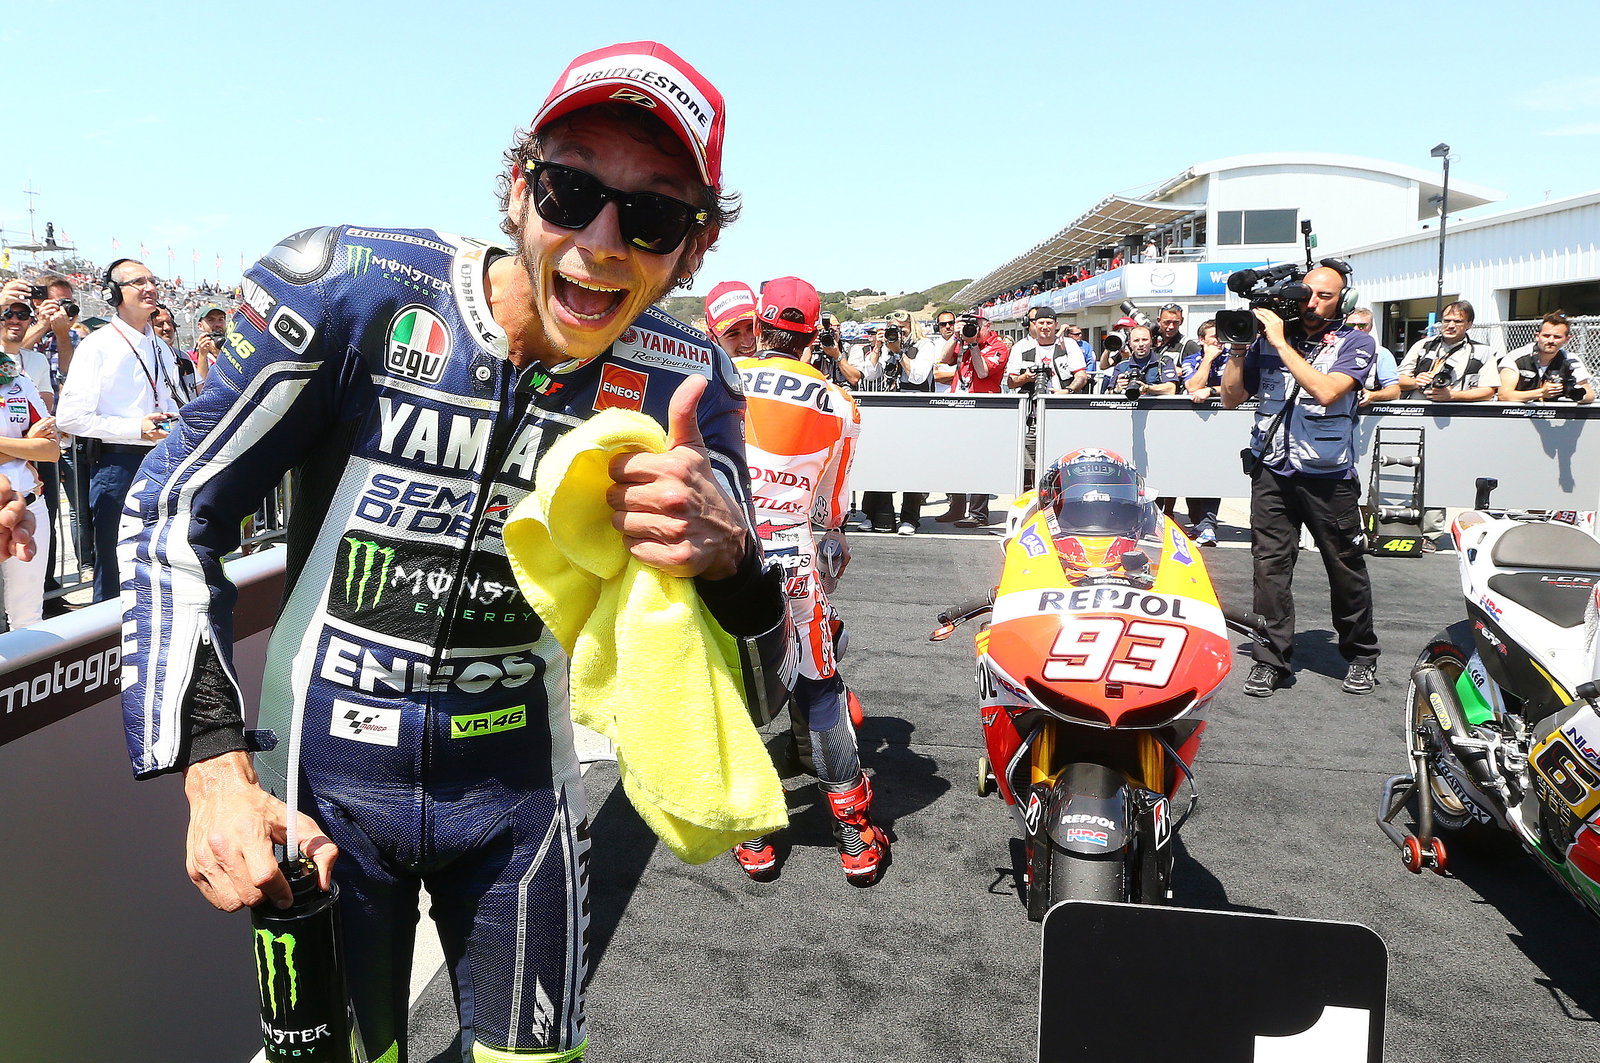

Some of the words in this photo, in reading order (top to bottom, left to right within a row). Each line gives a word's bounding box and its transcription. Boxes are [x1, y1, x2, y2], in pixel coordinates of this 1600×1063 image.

[349, 228, 455, 256] BRIDGESTONE
[372, 255, 454, 295] MONSTER
[382, 272, 438, 299] ENERGY
[639, 330, 711, 365] YAMAHA
[391, 344, 440, 378] agv
[602, 382, 641, 401] ENEOS
[929, 399, 976, 407] motogp.com
[1089, 400, 1139, 409] motogp.com
[1372, 405, 1425, 415] motogp.com
[1502, 407, 1556, 417] motogp.com
[1383, 539, 1416, 552] 46
[1540, 575, 1592, 583] LCR
[1038, 587, 1187, 620] REPSOL
[1042, 616, 1190, 689] 93
[319, 635, 537, 695] ENEOS
[1471, 669, 1486, 689] CEA
[1061, 814, 1116, 830] REPSOL
[1067, 828, 1108, 847] HRC
